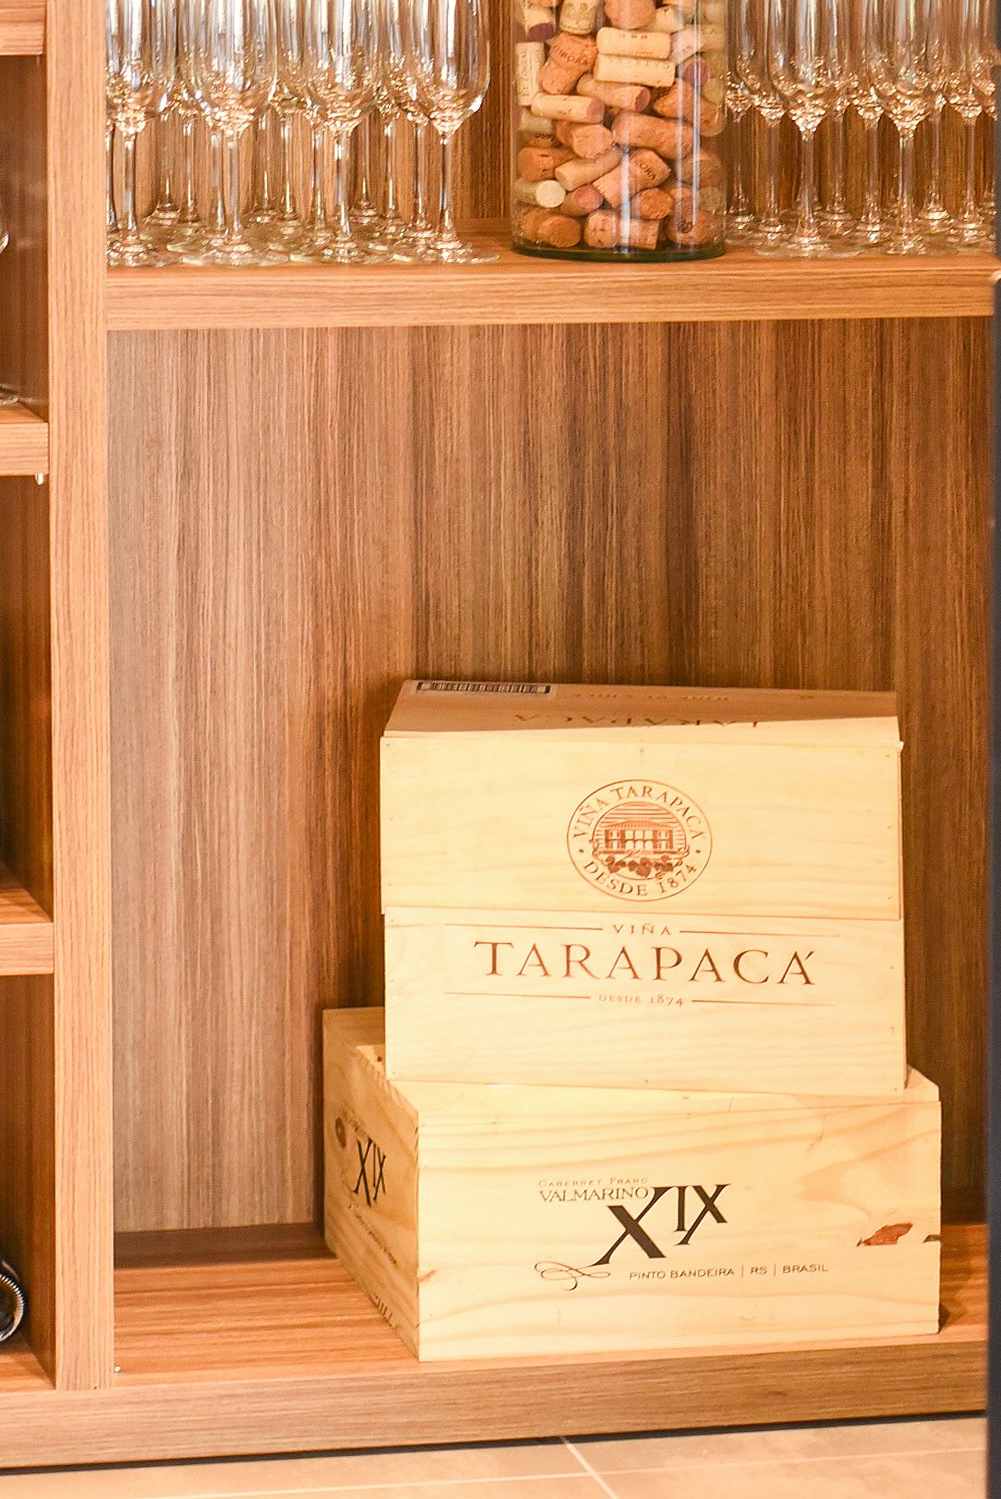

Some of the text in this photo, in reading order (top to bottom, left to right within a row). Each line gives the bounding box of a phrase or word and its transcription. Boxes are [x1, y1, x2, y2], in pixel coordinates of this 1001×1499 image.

[583, 860, 697, 897] DESDE 1874
[612, 922, 672, 936] VIÑA
[472, 940, 816, 986] TARAPACÁ
[598, 994, 685, 1007] DESDE 1874
[353, 1137, 387, 1208] XIX
[539, 1186, 649, 1203] VALMARINO
[587, 1183, 733, 1267] XIX
[629, 1264, 829, 1281] PINTO BANDEIRA RS BRASIL
